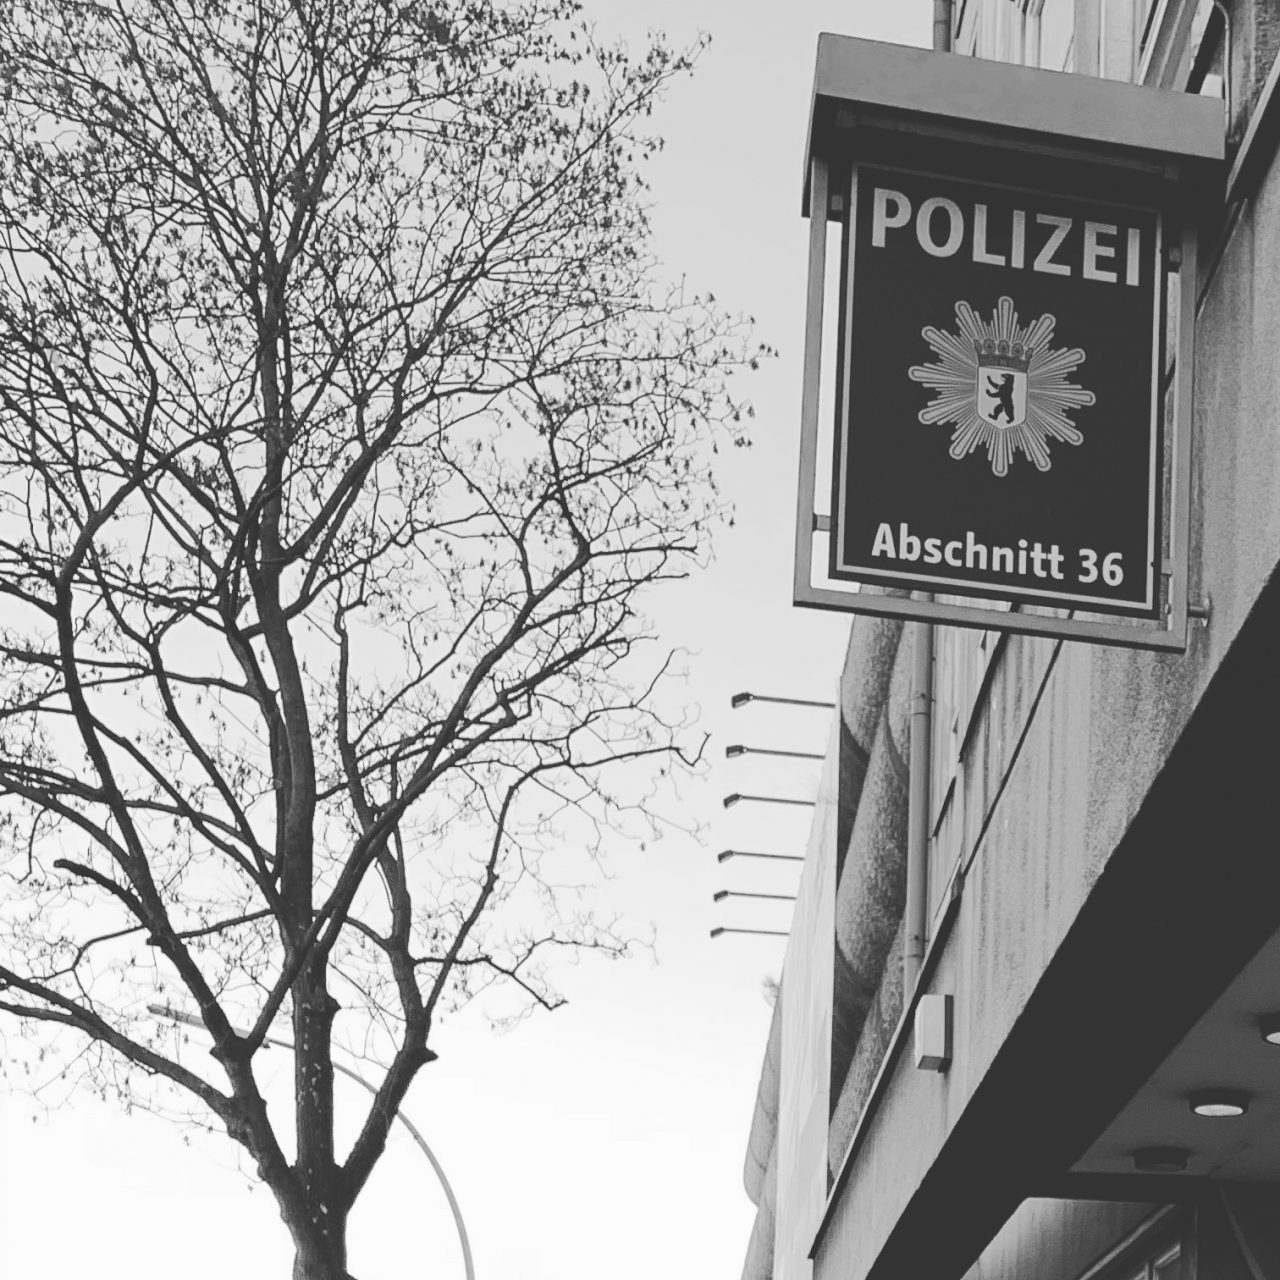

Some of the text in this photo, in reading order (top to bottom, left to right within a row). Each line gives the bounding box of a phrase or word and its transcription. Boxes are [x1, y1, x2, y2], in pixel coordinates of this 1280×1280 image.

[872, 187, 1140, 287] POLIZEI
[871, 522, 1125, 587] Abschnitt 36
